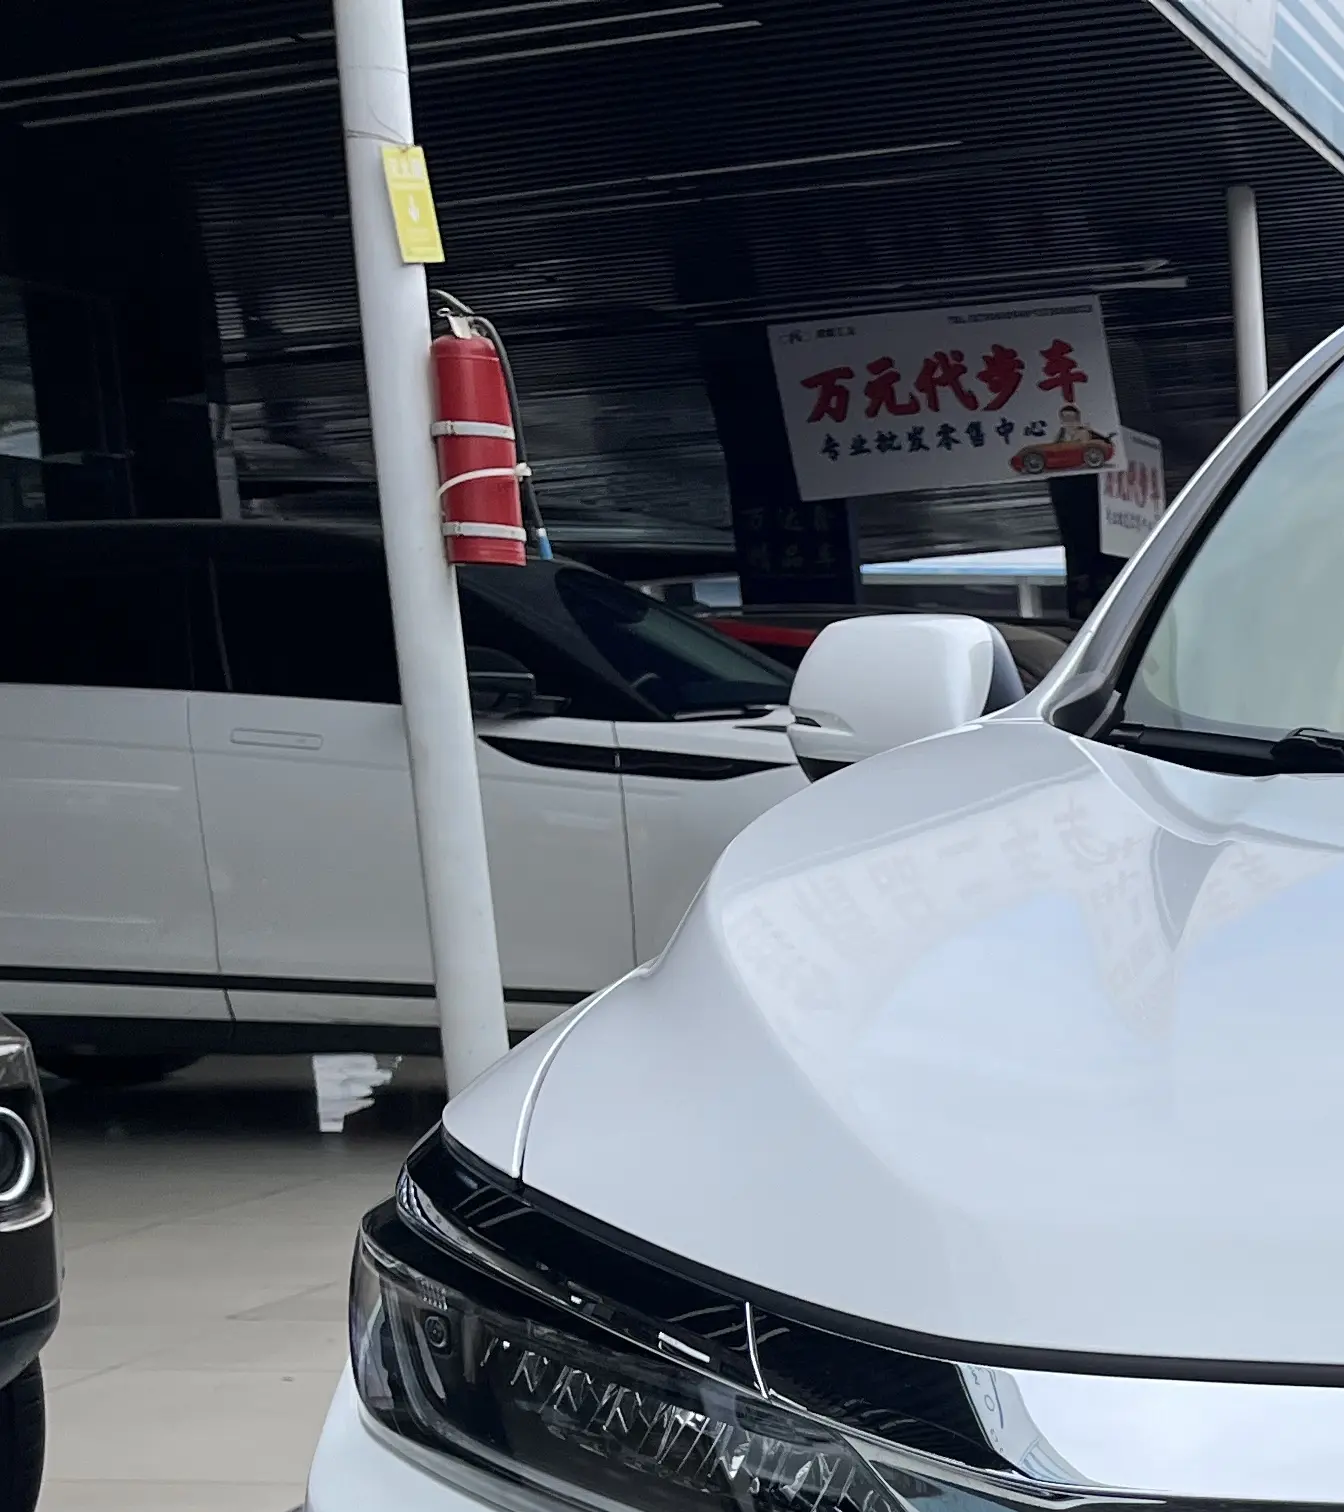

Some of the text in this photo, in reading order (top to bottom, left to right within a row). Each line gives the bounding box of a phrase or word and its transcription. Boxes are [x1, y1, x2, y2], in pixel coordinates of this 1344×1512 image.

[800, 338, 1090, 423] 万元代步车
[820, 417, 1048, 461] 专业批发零售中心
